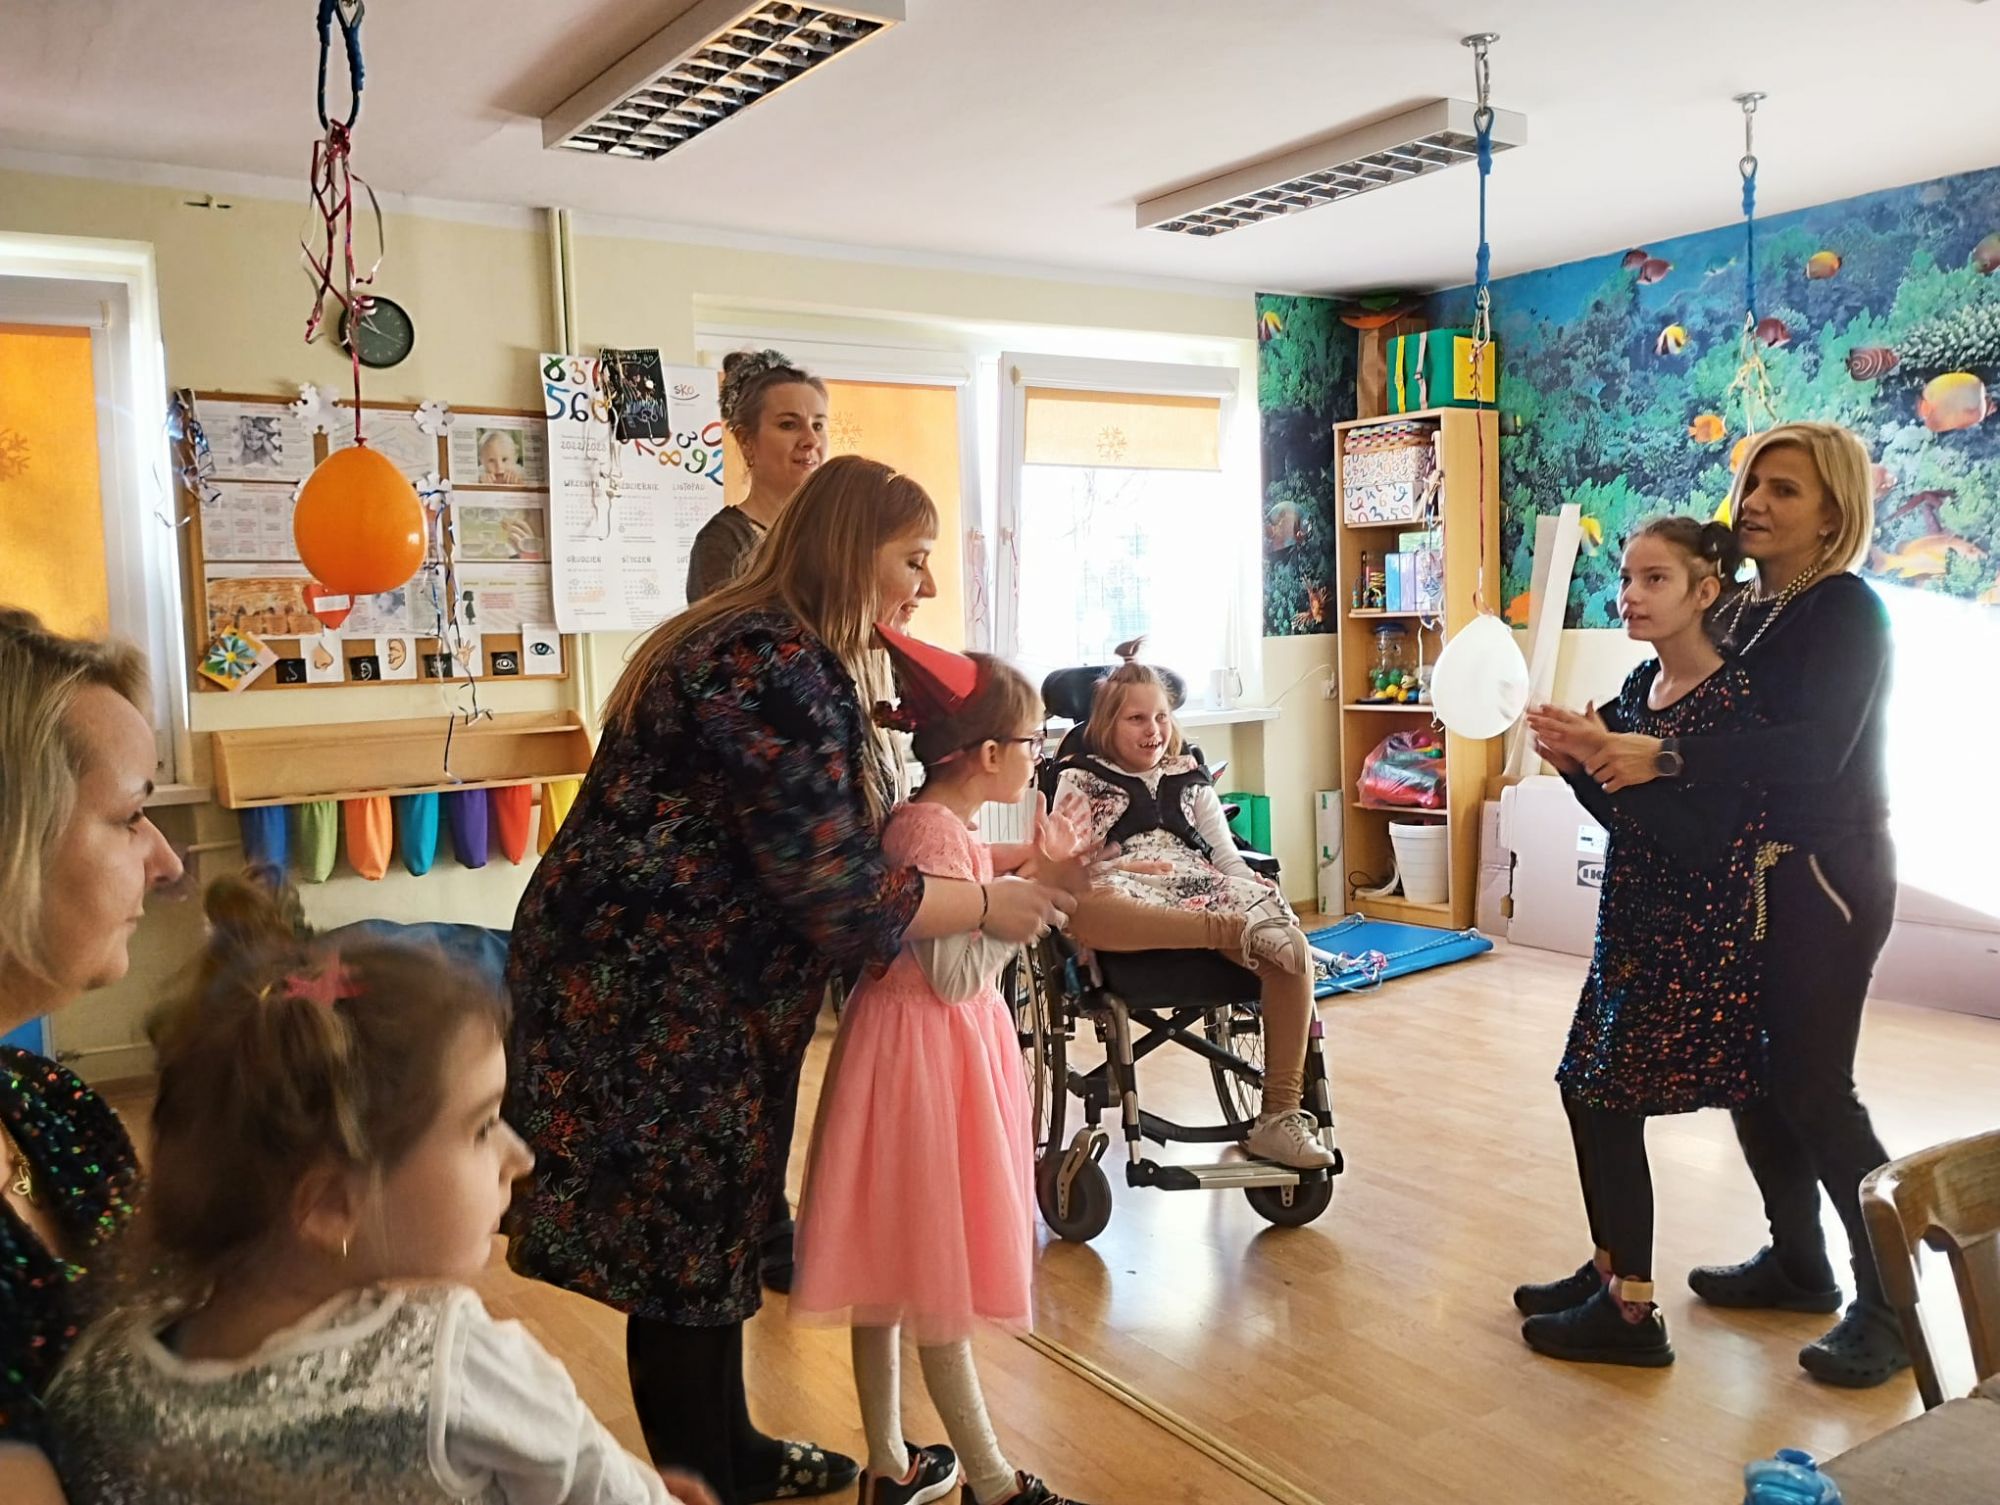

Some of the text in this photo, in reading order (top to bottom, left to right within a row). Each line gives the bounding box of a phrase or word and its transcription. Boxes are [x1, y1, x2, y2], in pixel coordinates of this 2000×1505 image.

[545, 383, 588, 422] 5 6
[684, 448, 708, 474] 9
[1582, 868, 1603, 880] IK
